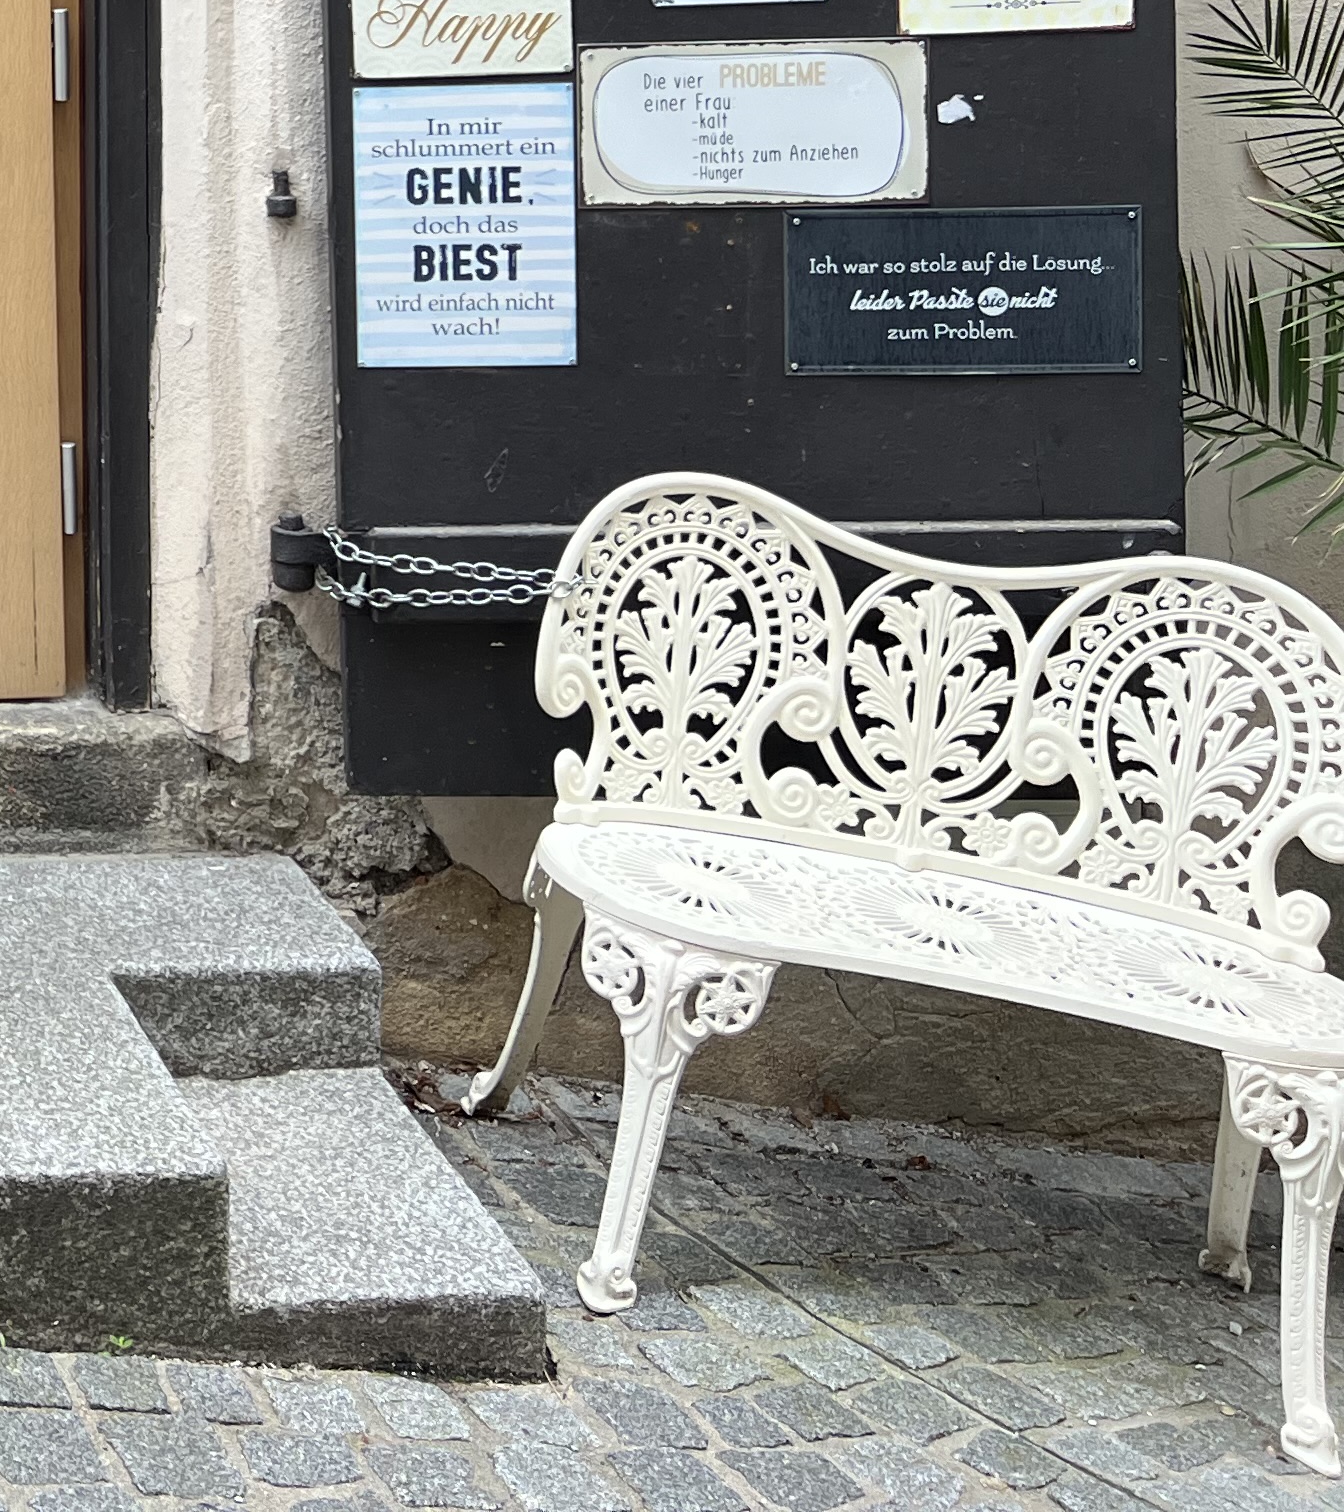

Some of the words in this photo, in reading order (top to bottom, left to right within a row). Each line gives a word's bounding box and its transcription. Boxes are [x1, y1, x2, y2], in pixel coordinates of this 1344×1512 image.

[644, 73, 666, 90] Die
[674, 74, 704, 89] vier
[719, 61, 826, 88] PROBLEME
[644, 96, 686, 112] einer
[426, 118, 451, 136] In
[459, 117, 502, 135] mir
[371, 139, 514, 158] schlummert
[519, 138, 556, 155] ein
[752, 149, 782, 163] zum
[789, 144, 860, 163] Anziehen
[413, 216, 470, 234] doch
[478, 215, 518, 233] das
[413, 243, 523, 282] BIEST
[809, 255, 838, 275] Ich
[843, 262, 879, 276] war
[883, 262, 906, 274] so
[909, 253, 957, 273] stolz
[962, 252, 996, 276] auf
[998, 252, 1027, 272] die
[377, 294, 422, 312] wird
[428, 292, 499, 312] einfach
[506, 292, 555, 311] nicht
[849, 289, 906, 311] leider
[908, 287, 975, 311] Passte
[978, 292, 1008, 309] sie
[1009, 286, 1058, 309] nicht
[432, 317, 500, 336] wach!
[887, 326, 929, 340] zum
